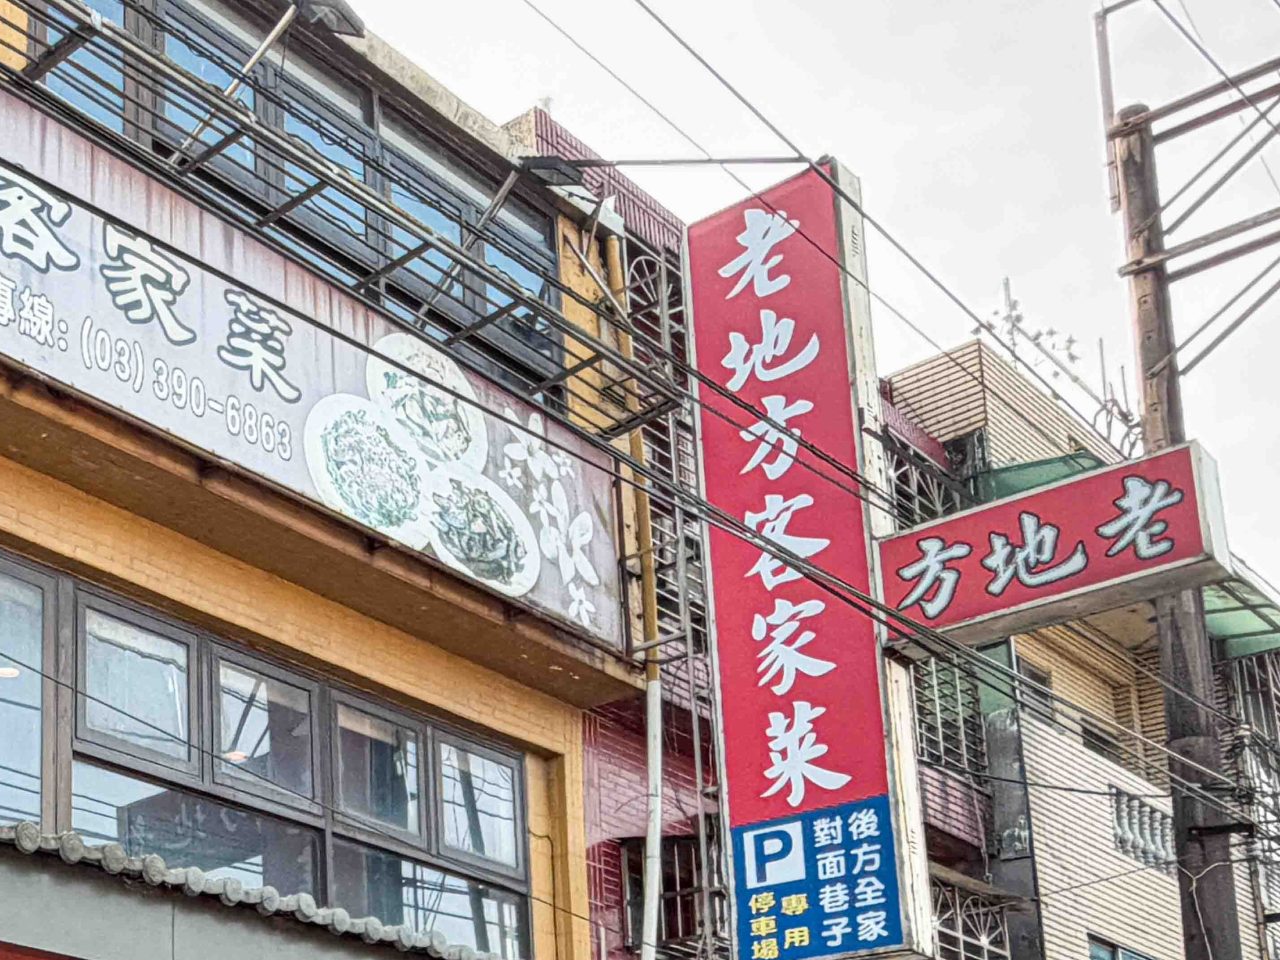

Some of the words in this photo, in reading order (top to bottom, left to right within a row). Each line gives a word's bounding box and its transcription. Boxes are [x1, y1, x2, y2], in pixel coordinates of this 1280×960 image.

[81, 316, 144, 393] (03)
[153, 359, 292, 462] 390-6863
[718, 208, 852, 808] 老地方客家菜
[753, 829, 794, 884] P
[780, 893, 812, 950] 專用
[812, 815, 853, 948] 對面巷子
[847, 808, 890, 943] 後方全家
